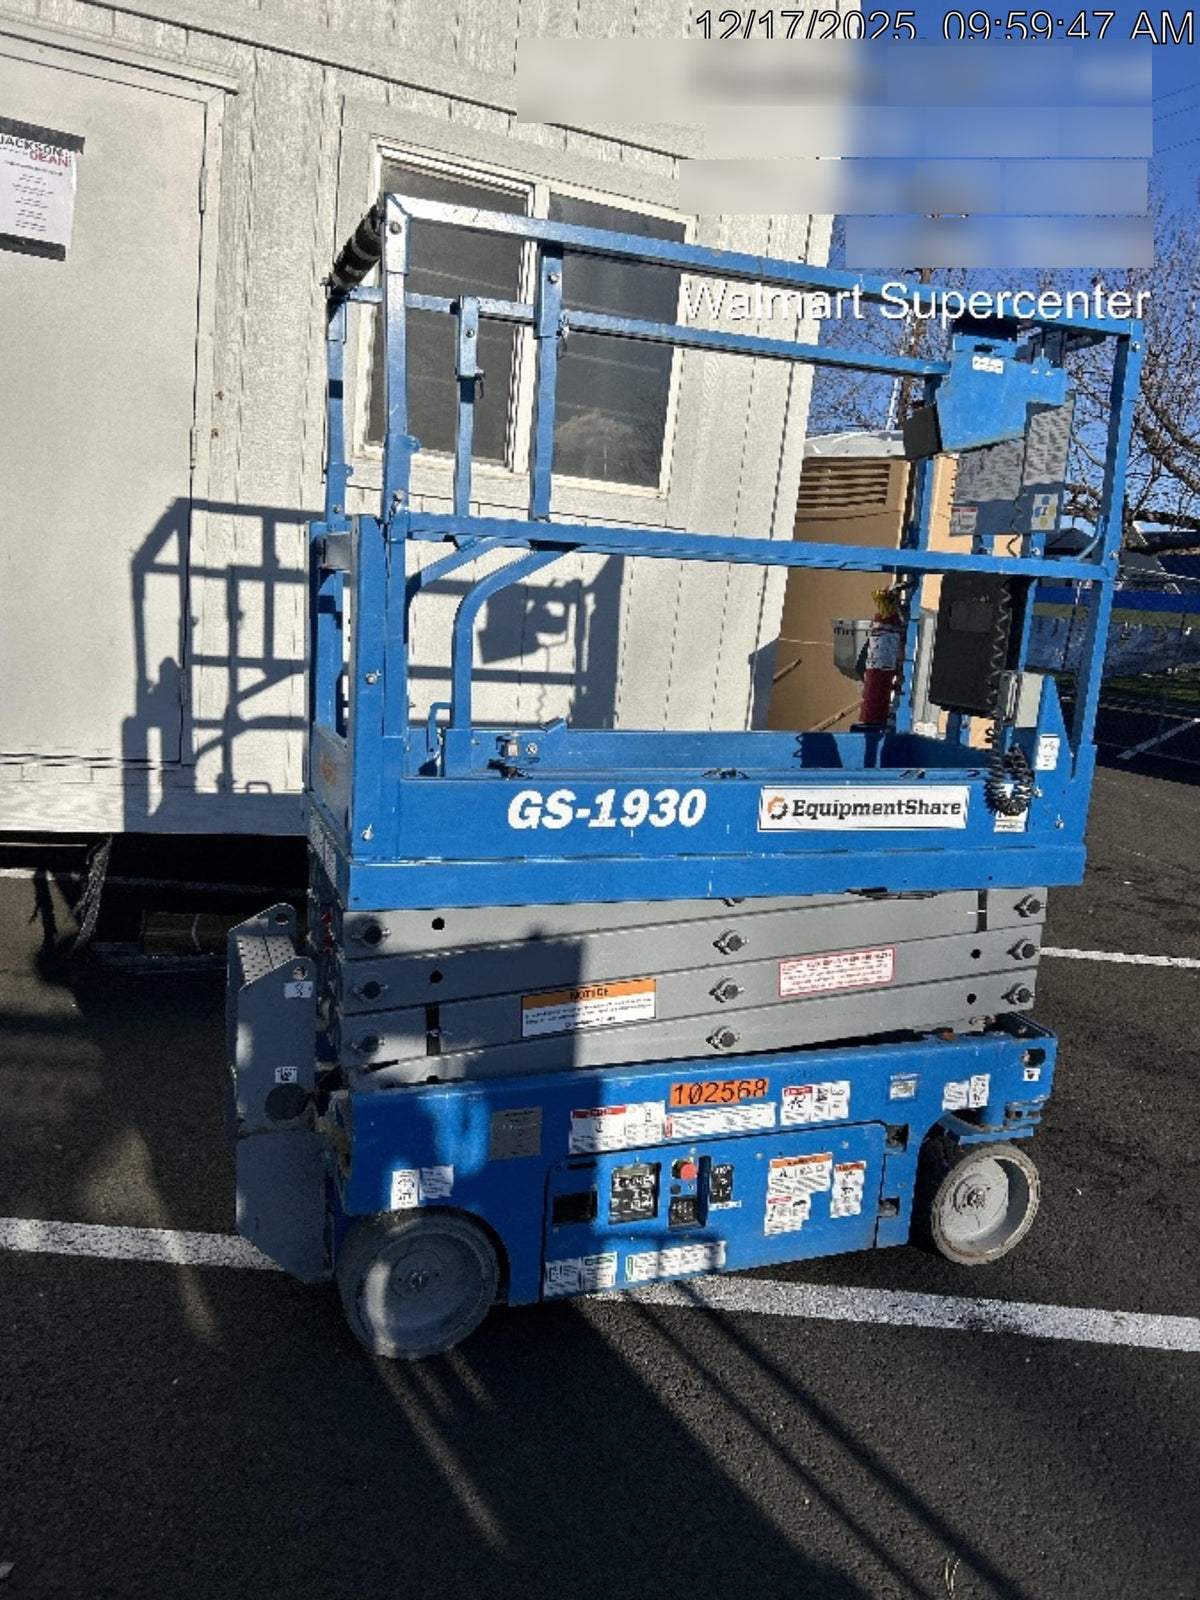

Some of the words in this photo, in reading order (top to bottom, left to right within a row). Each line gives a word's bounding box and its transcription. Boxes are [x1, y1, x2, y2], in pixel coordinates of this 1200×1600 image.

[29, 149, 69, 167] DEAN
[508, 788, 707, 829] GS-1930
[792, 799, 961, 820] EquipmentShare
